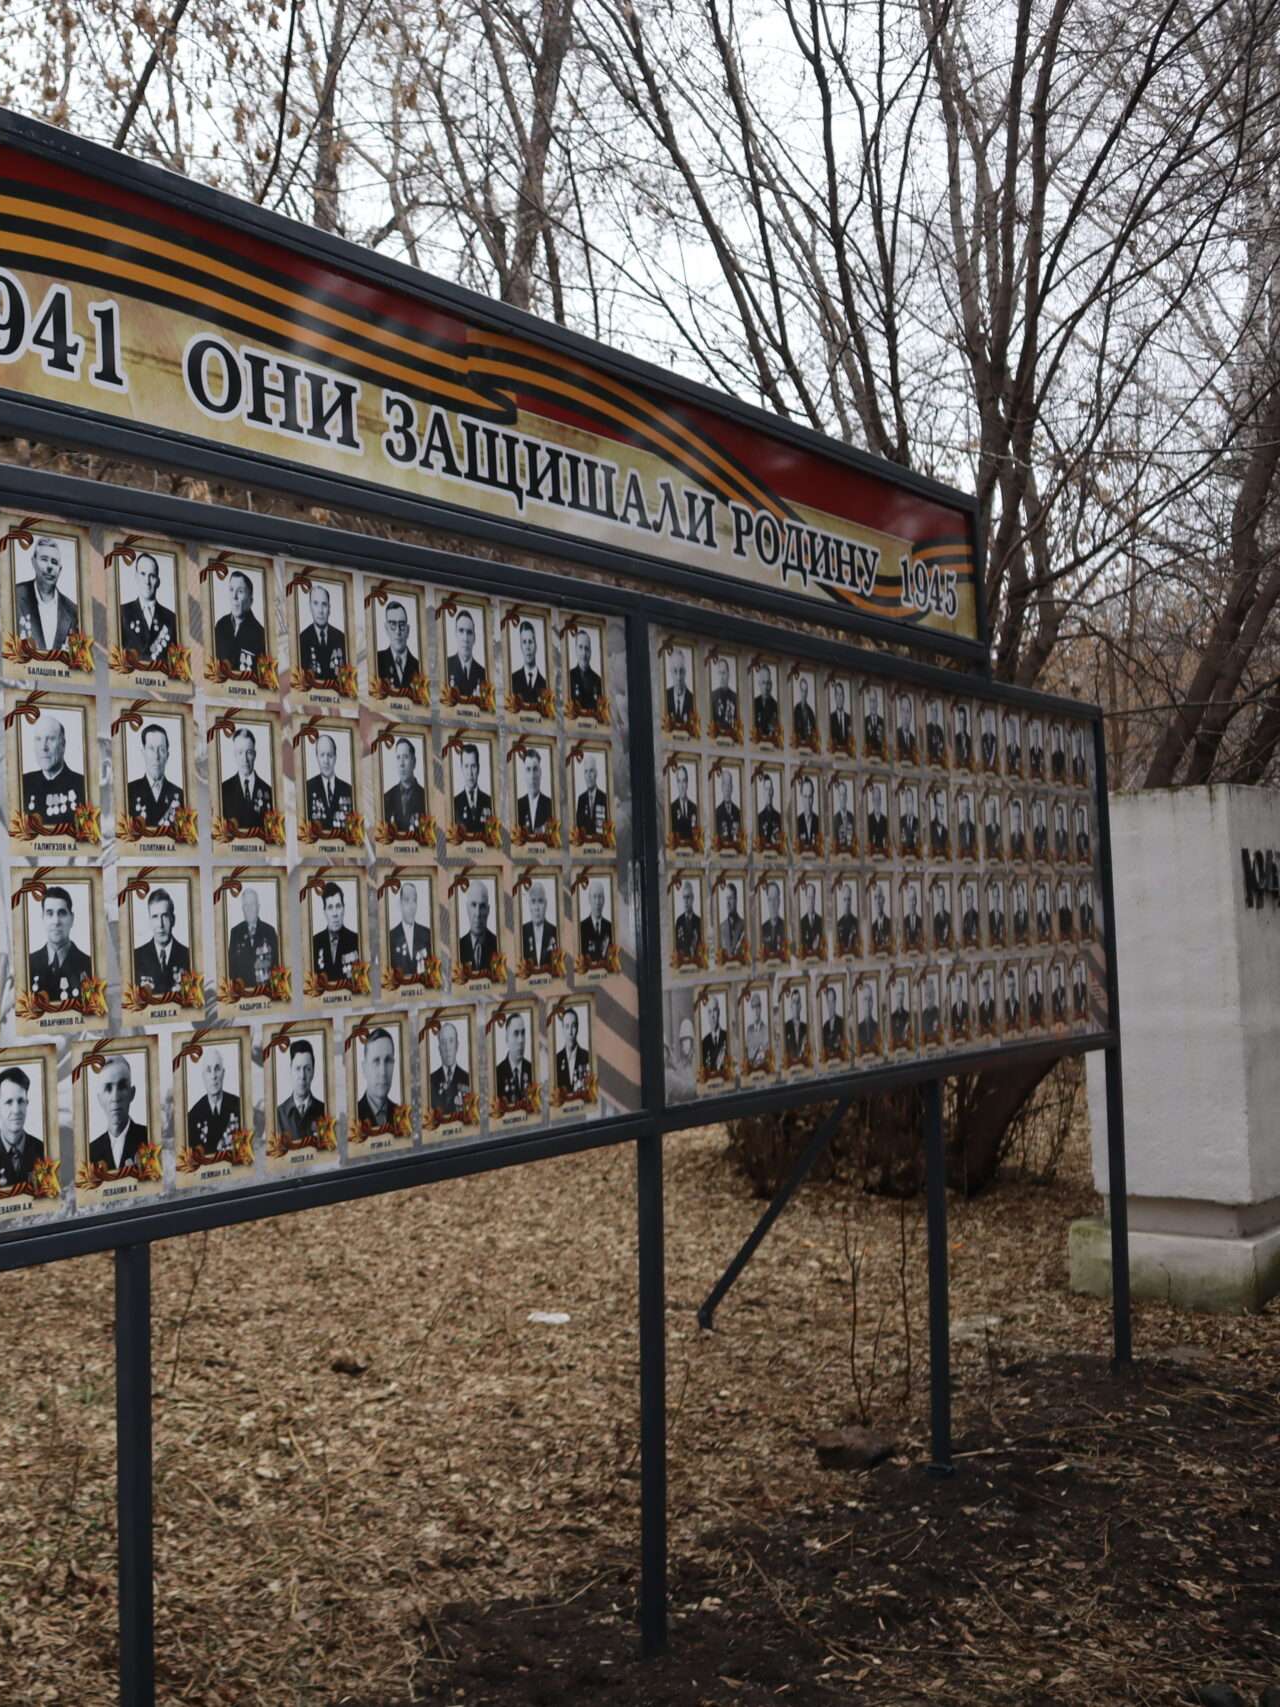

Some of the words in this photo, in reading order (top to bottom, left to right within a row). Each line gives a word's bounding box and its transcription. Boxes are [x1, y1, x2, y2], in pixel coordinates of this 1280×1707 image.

[186, 339, 360, 450] ОНИ
[731, 506, 879, 594] РОДИНУ
[900, 559, 957, 616] 1945
